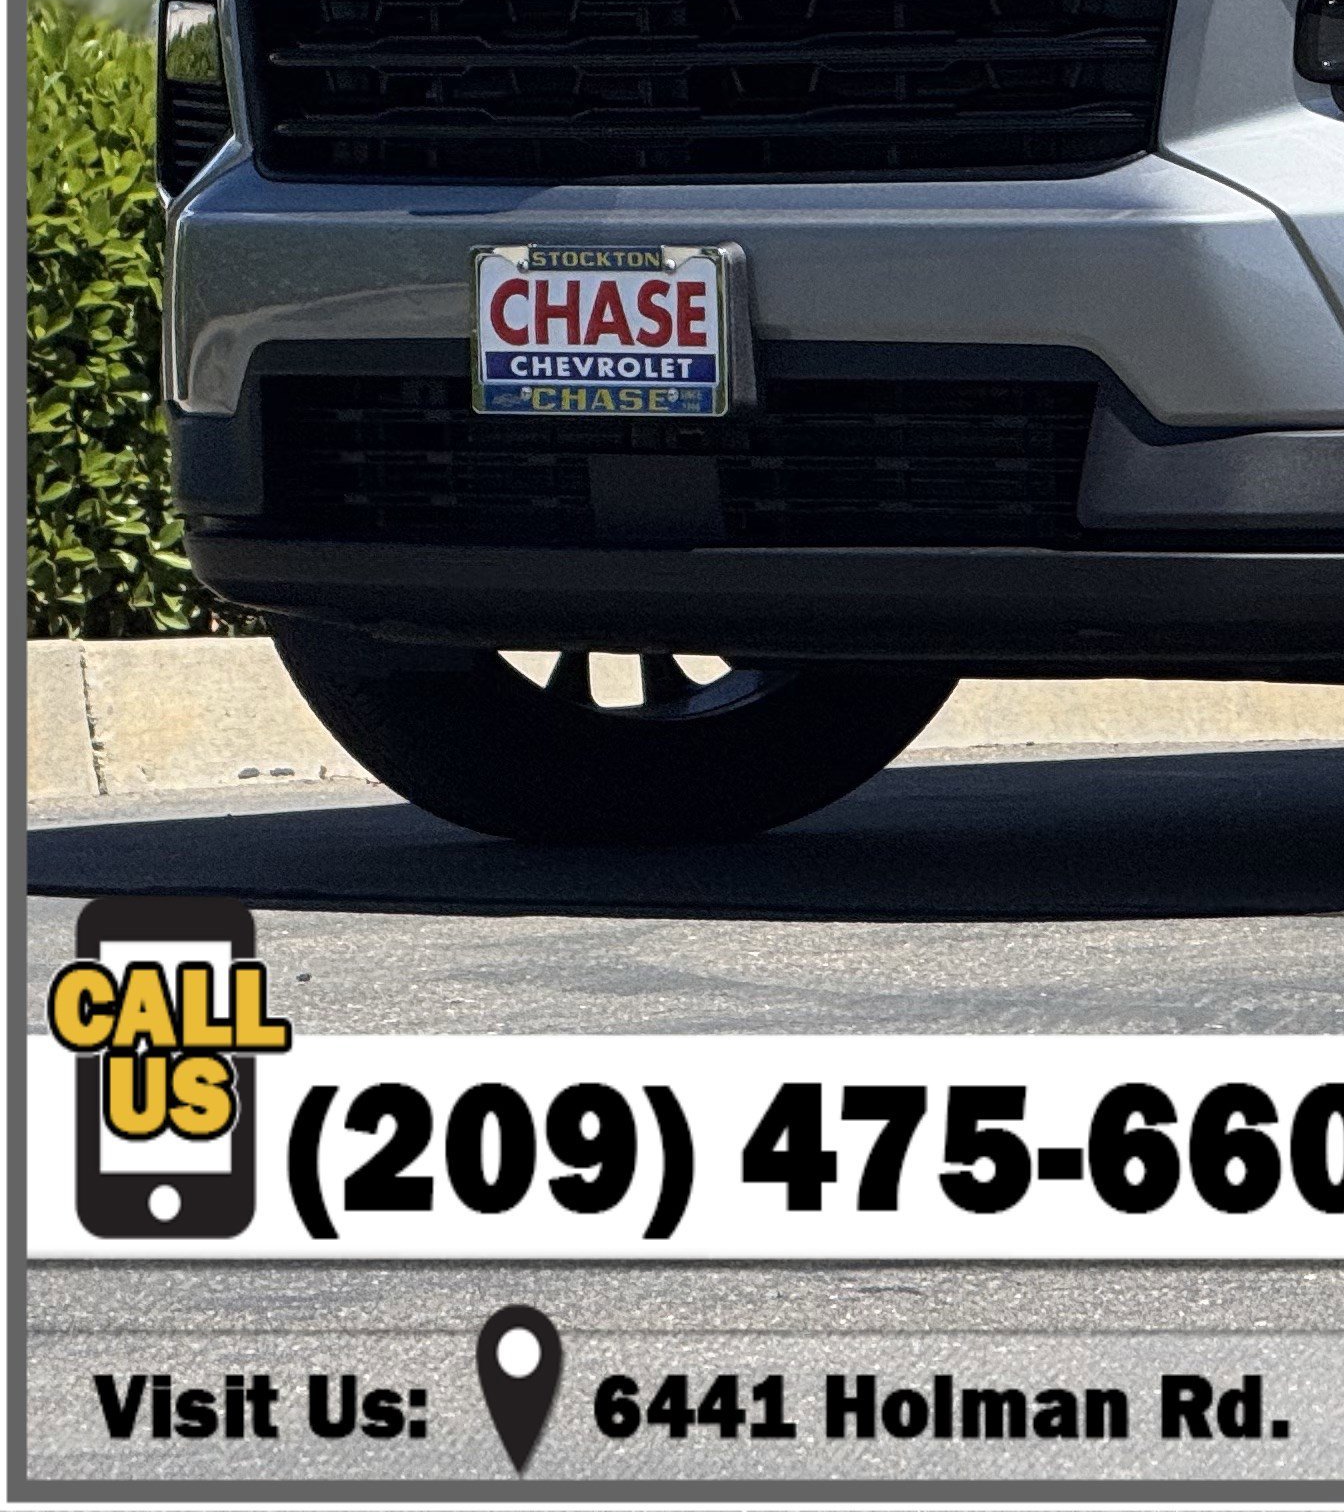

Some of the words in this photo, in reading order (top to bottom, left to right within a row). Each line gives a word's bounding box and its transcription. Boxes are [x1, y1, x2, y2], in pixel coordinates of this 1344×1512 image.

[531, 250, 662, 268] STOCKTON
[490, 278, 707, 348] CHASE
[510, 355, 692, 379] CHEVROLET
[531, 387, 669, 411] CHASE
